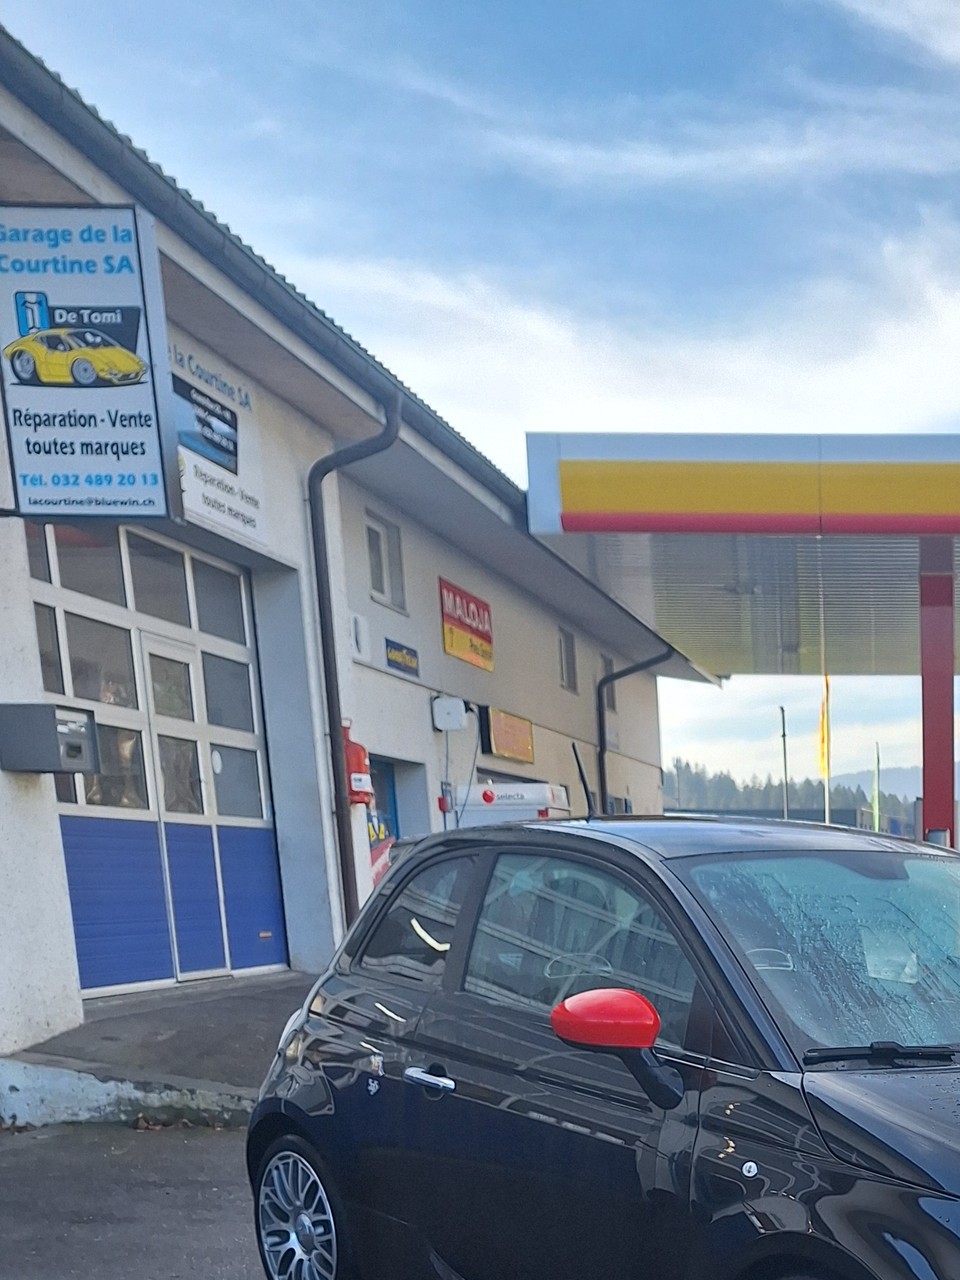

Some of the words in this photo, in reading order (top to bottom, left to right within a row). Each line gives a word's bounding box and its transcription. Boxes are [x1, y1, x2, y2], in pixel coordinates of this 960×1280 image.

[79, 224, 107, 243] de
[112, 224, 133, 243] la
[0, 255, 98, 274] Courtine
[103, 255, 135, 274] SA
[54, 308, 77, 323] De
[79, 308, 121, 324] Tomi
[12, 407, 98, 432] Réparation
[107, 409, 153, 428] Vente
[25, 437, 76, 456] toutes
[80, 441, 147, 461] marques
[51, 473, 80, 487] 032
[84, 473, 113, 487] 489
[117, 473, 137, 487] 20
[141, 473, 159, 487] 13
[442, 587, 493, 633] MALOJA
[497, 791, 525, 801] selecta
